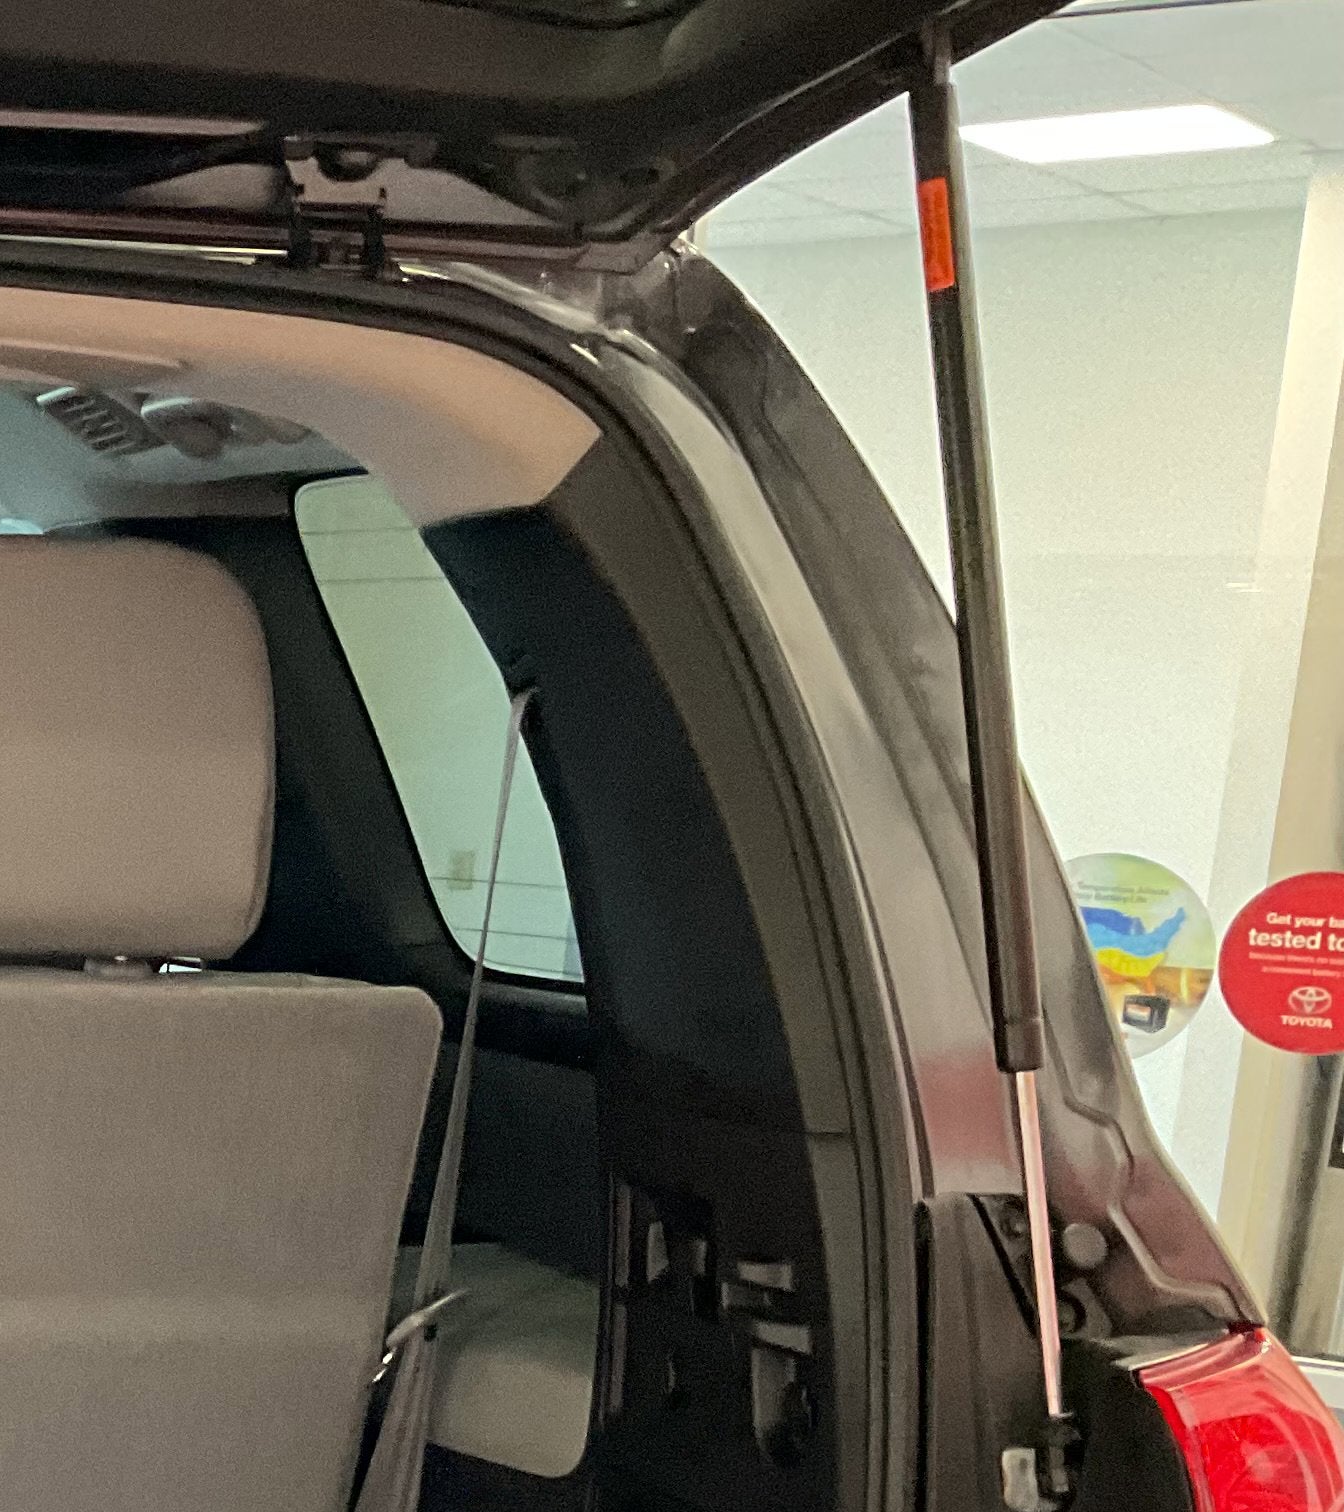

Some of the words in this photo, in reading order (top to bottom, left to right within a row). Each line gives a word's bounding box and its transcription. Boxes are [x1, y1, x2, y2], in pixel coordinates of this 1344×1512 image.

[1266, 912, 1291, 925] Get
[1294, 917, 1326, 928] your
[1249, 928, 1322, 950] tested
[1281, 1015, 1333, 1029] TOYOTA
